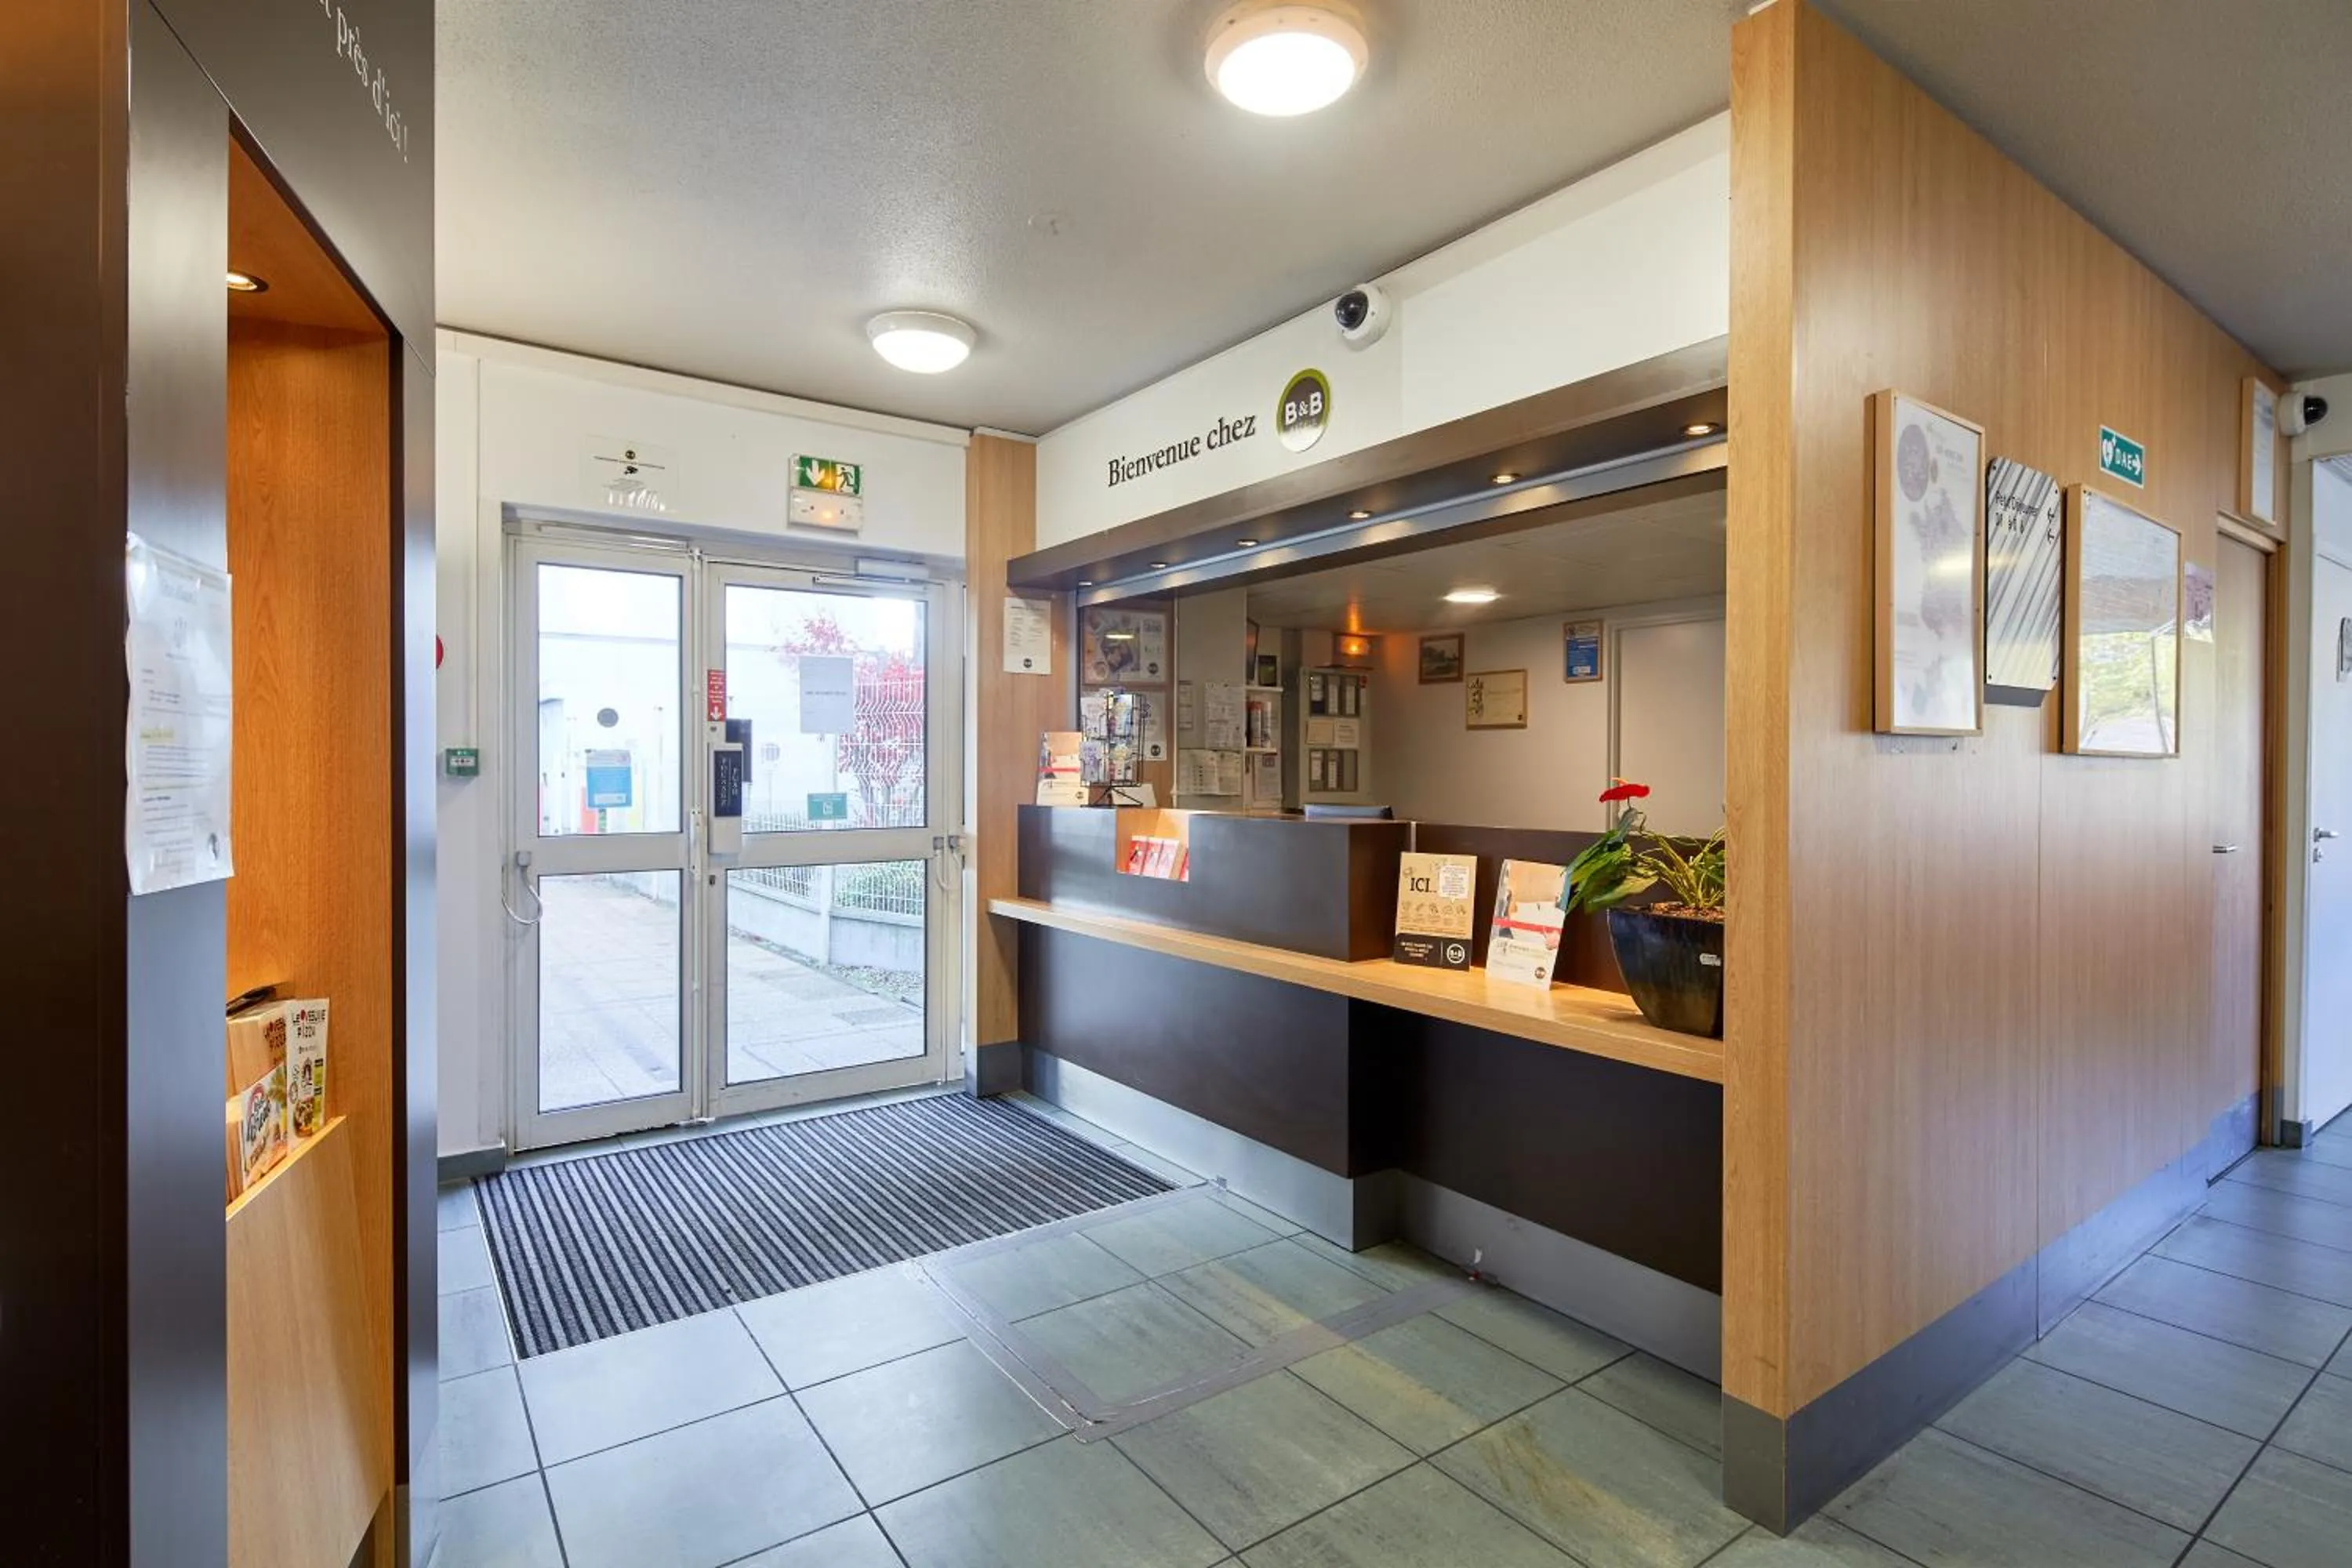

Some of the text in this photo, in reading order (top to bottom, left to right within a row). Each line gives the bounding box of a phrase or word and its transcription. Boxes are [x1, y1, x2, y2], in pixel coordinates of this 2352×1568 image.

[1285, 391, 1323, 426] B&B
[1108, 415, 1256, 488] Bienvenue chez
[2114, 448, 2132, 470] DAE
